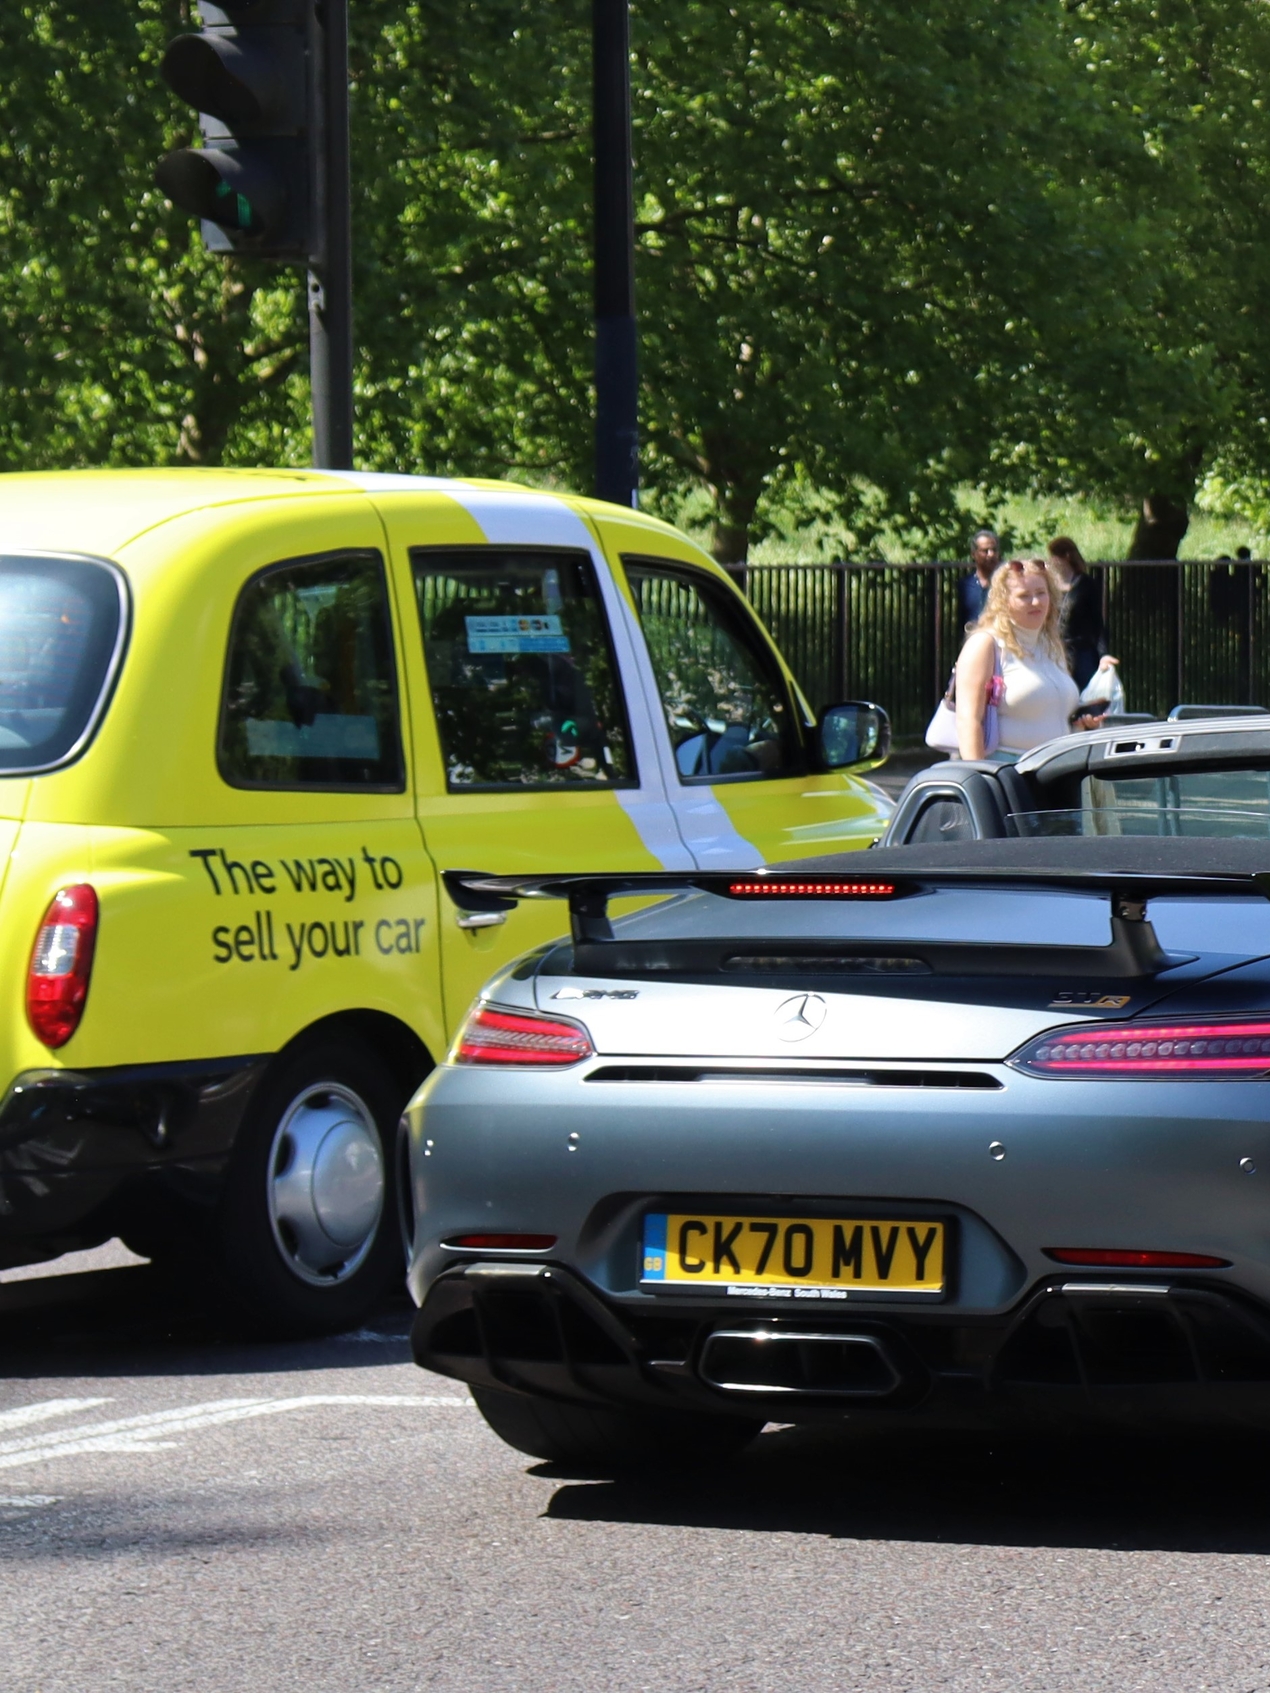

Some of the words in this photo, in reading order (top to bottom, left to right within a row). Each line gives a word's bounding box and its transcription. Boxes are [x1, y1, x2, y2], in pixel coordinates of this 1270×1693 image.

[189, 848, 276, 896] The
[279, 857, 356, 902] way
[361, 846, 403, 891] to
[212, 909, 278, 964] sell
[286, 919, 364, 972] your
[374, 917, 426, 956] car
[678, 1220, 814, 1278] CK70
[831, 1224, 938, 1281] MVY
[726, 1286, 792, 1298] Mercedes-Benz
[793, 1287, 820, 1299] South
[820, 1289, 848, 1300] Wales
